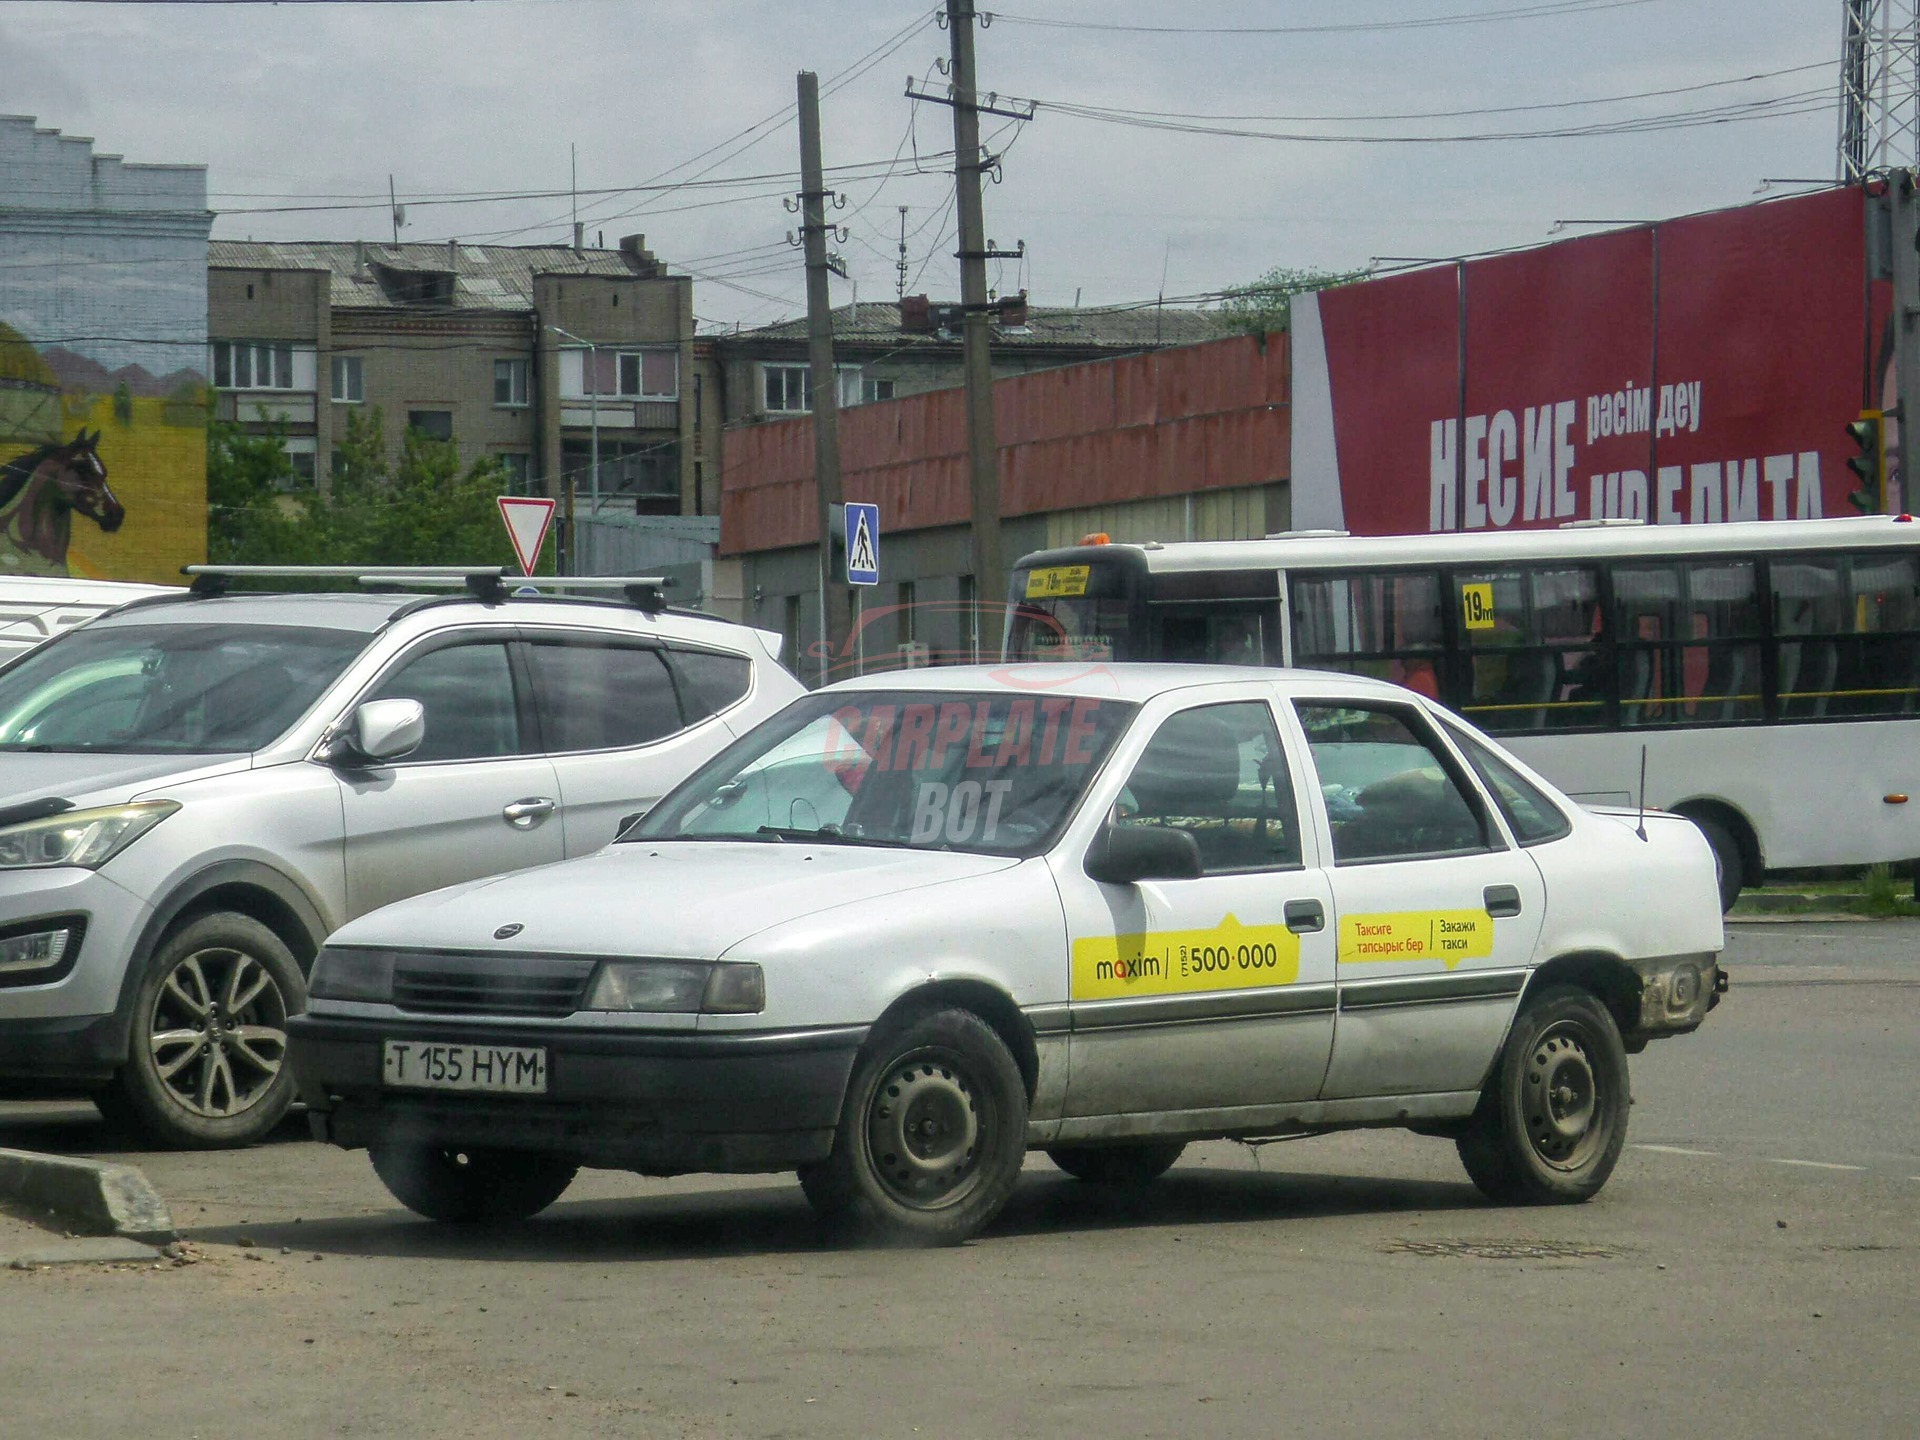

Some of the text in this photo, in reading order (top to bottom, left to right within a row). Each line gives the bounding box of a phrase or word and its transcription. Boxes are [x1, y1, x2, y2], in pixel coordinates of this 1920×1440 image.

[1430, 400, 1576, 532] НЕСИЕ
[1355, 923, 1392, 936] Таксиге
[1440, 919, 1476, 932] Закажи
[1357, 938, 1423, 955] тапсырыс бер
[1441, 938, 1468, 950] такси
[1096, 952, 1160, 980] maxim
[392, 1045, 538, 1086] T 155 HYM
